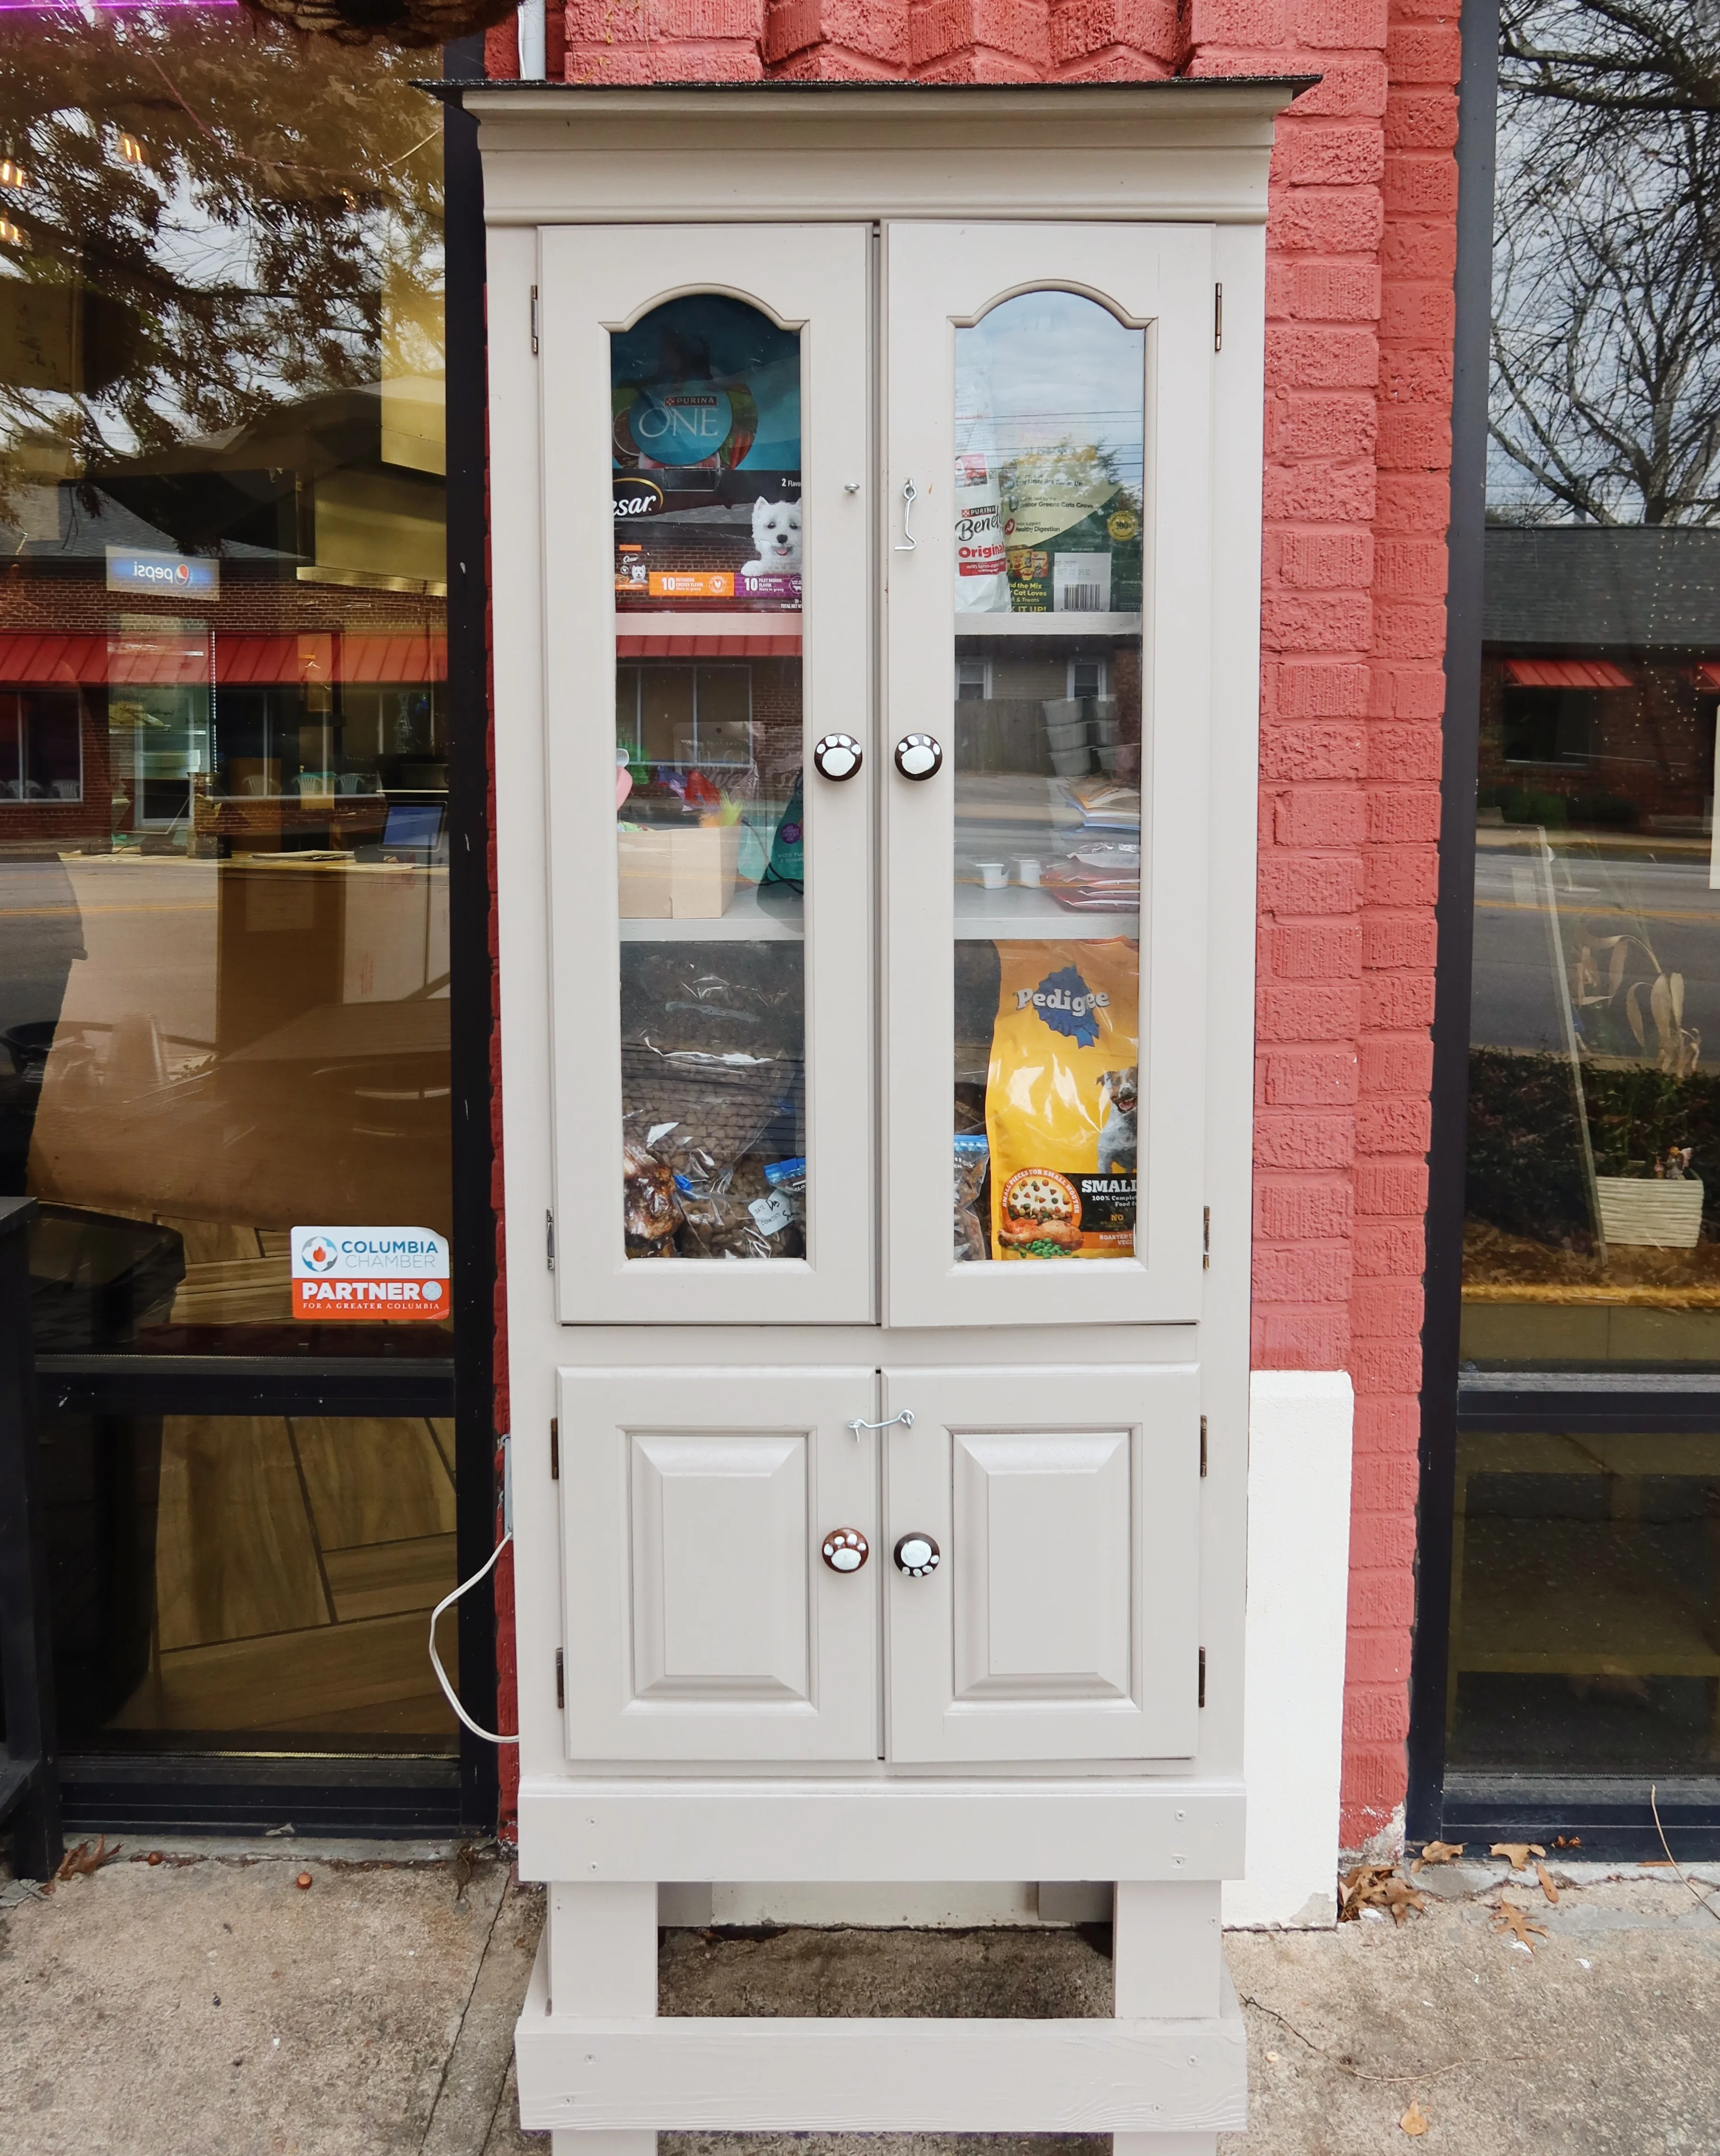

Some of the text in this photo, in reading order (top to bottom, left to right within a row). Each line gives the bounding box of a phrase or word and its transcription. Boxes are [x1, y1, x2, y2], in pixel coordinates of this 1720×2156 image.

[638, 407, 719, 437] ONE
[781, 478, 786, 486] 2
[970, 506, 995, 515] PURINA
[959, 542, 1005, 558] Original
[662, 577, 675, 591] 10
[744, 577, 758, 591] 10
[1002, 1185, 1011, 1208] SMALL
[1009, 1170, 1029, 1185] PIECES
[1043, 1170, 1067, 1185] SMALL
[1065, 1184, 1080, 1214] MOUTHS
[754, 1204, 766, 1214] DATE
[341, 1241, 438, 1253] COLUMBIA
[346, 1254, 436, 1268] CHAMBER
[302, 1282, 421, 1300] PARTNER
